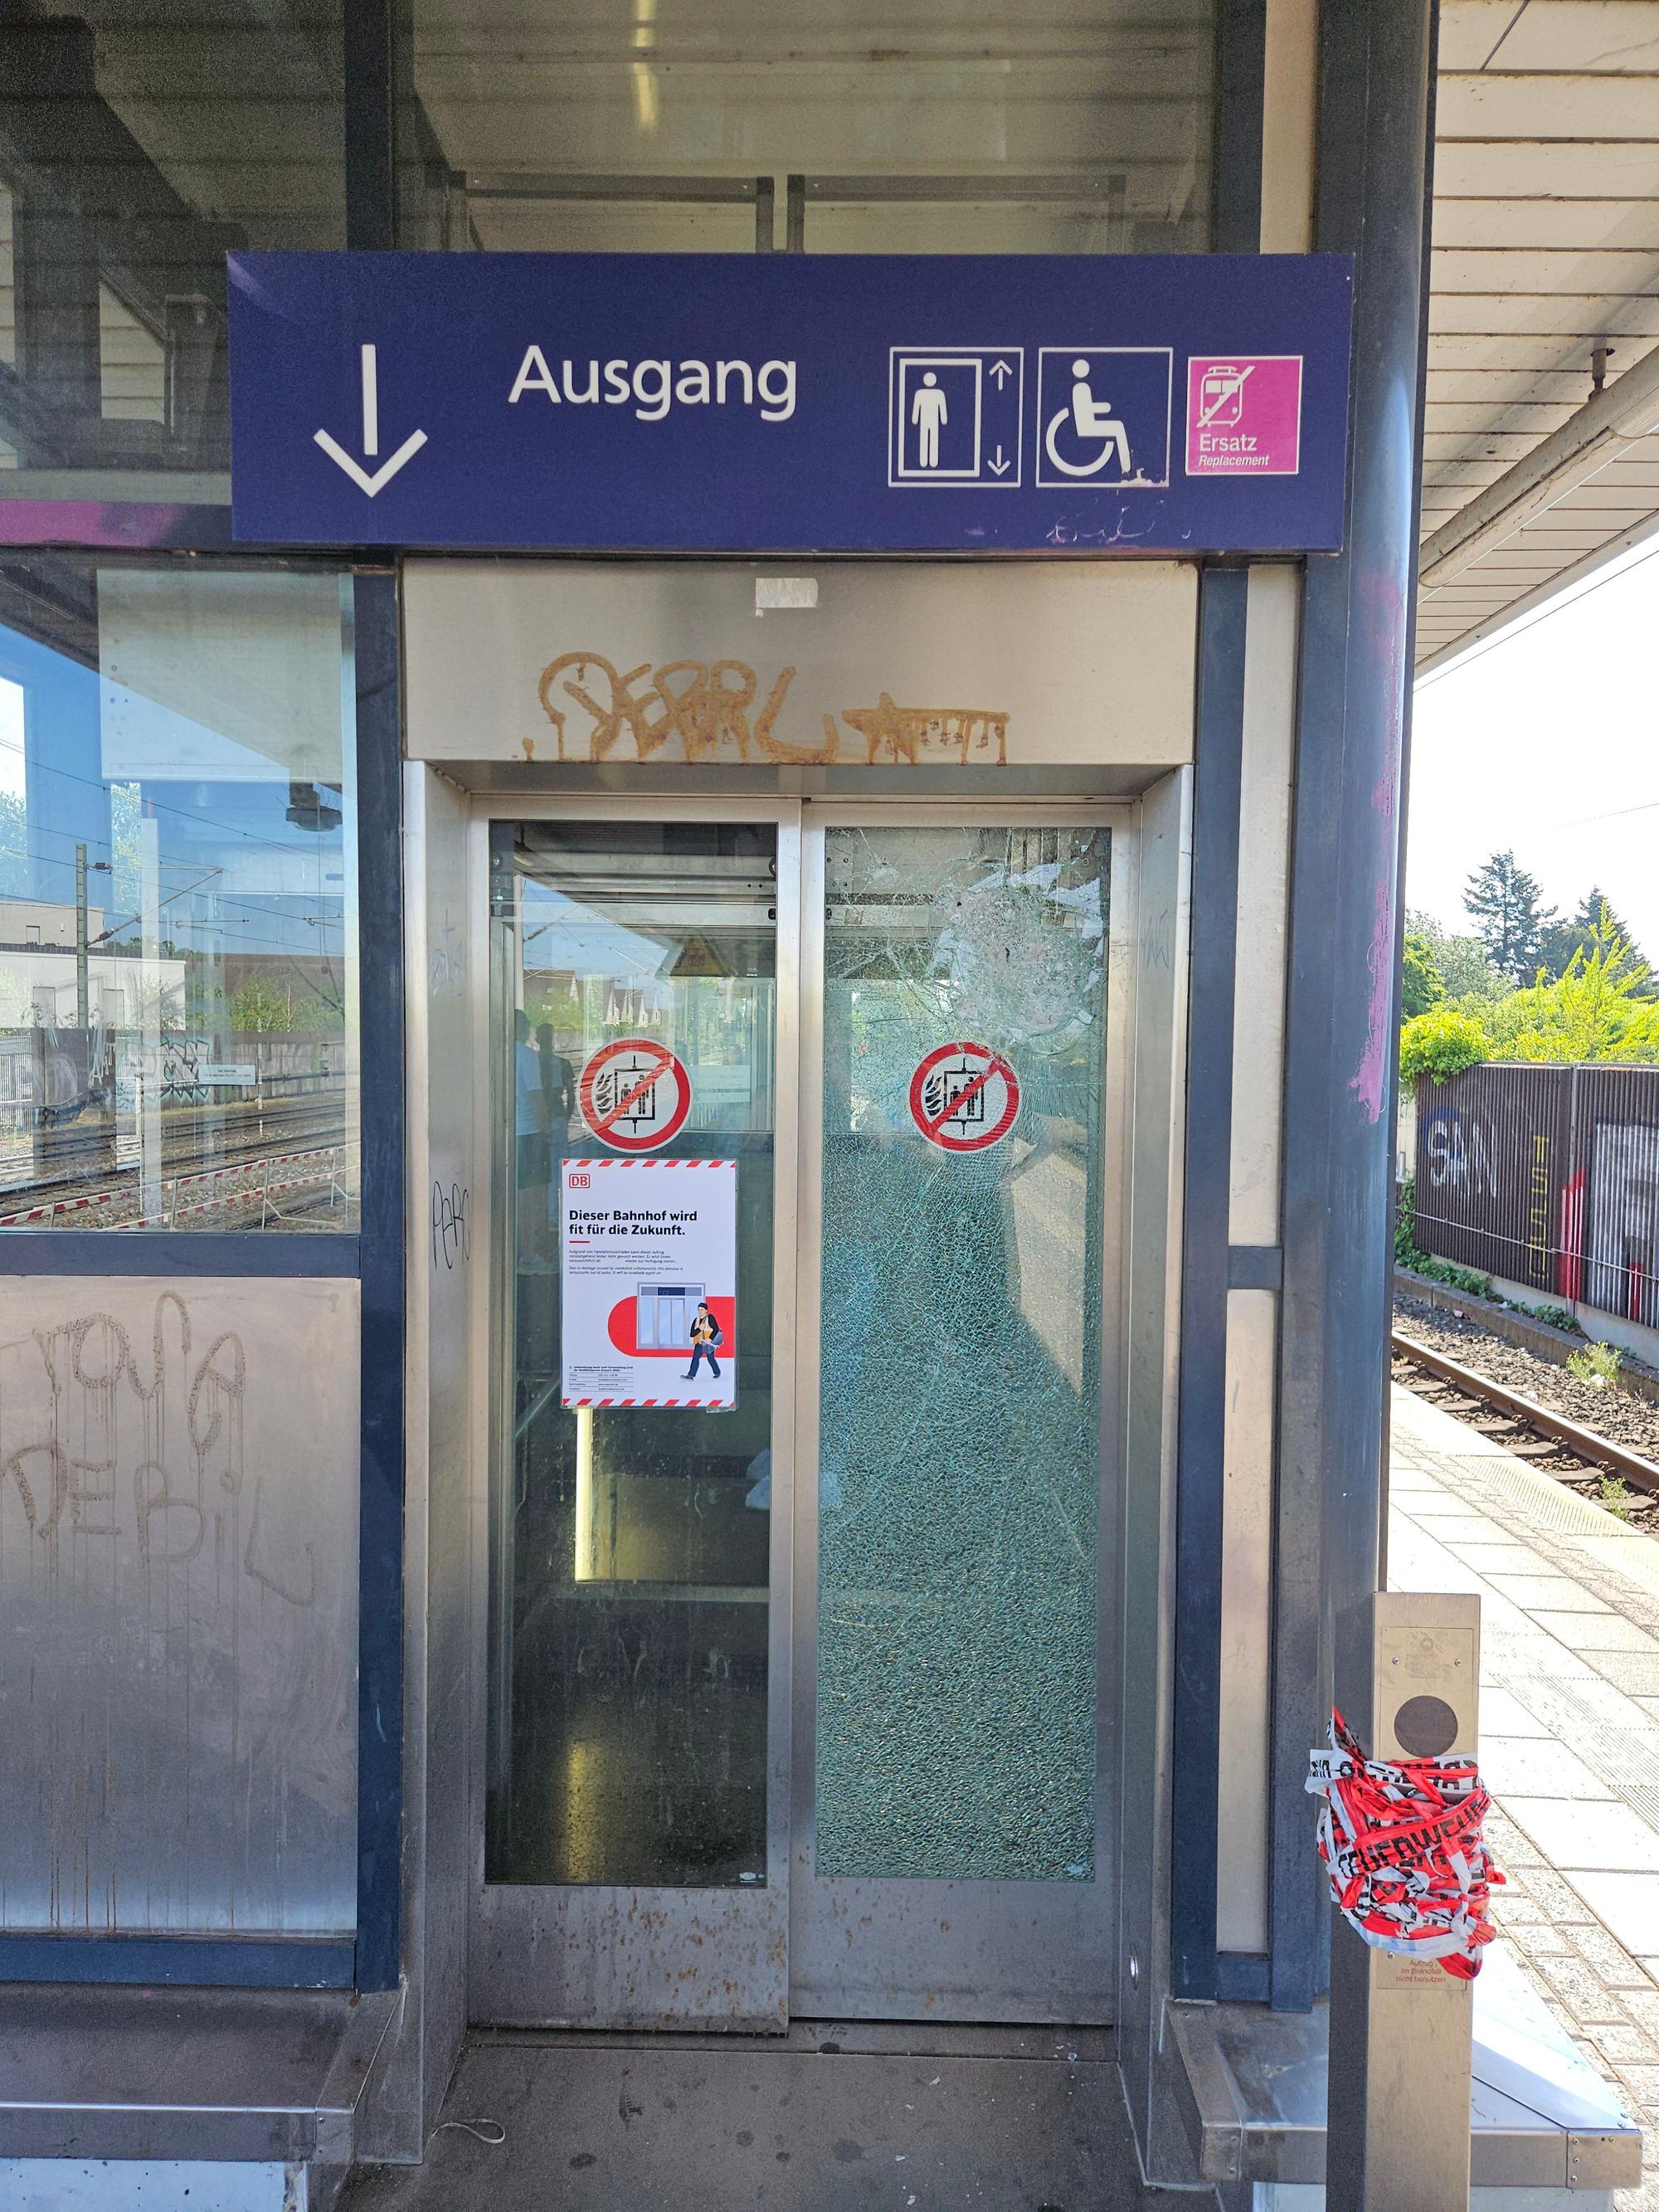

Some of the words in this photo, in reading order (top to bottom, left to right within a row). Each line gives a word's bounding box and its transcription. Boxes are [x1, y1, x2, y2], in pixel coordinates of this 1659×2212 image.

[508, 345, 796, 421] Ausgang
[1199, 433, 1258, 452] Ersatz
[1199, 454, 1270, 469] Replacement
[571, 1176, 588, 1186] DB
[569, 1210, 610, 1220] Dieser
[613, 1210, 667, 1220] Bahnhof
[670, 1210, 698, 1221] wird
[569, 1224, 583, 1235] fit
[586, 1224, 606, 1235] für
[608, 1224, 628, 1235] die
[631, 1225, 685, 1235] Zukunft.
